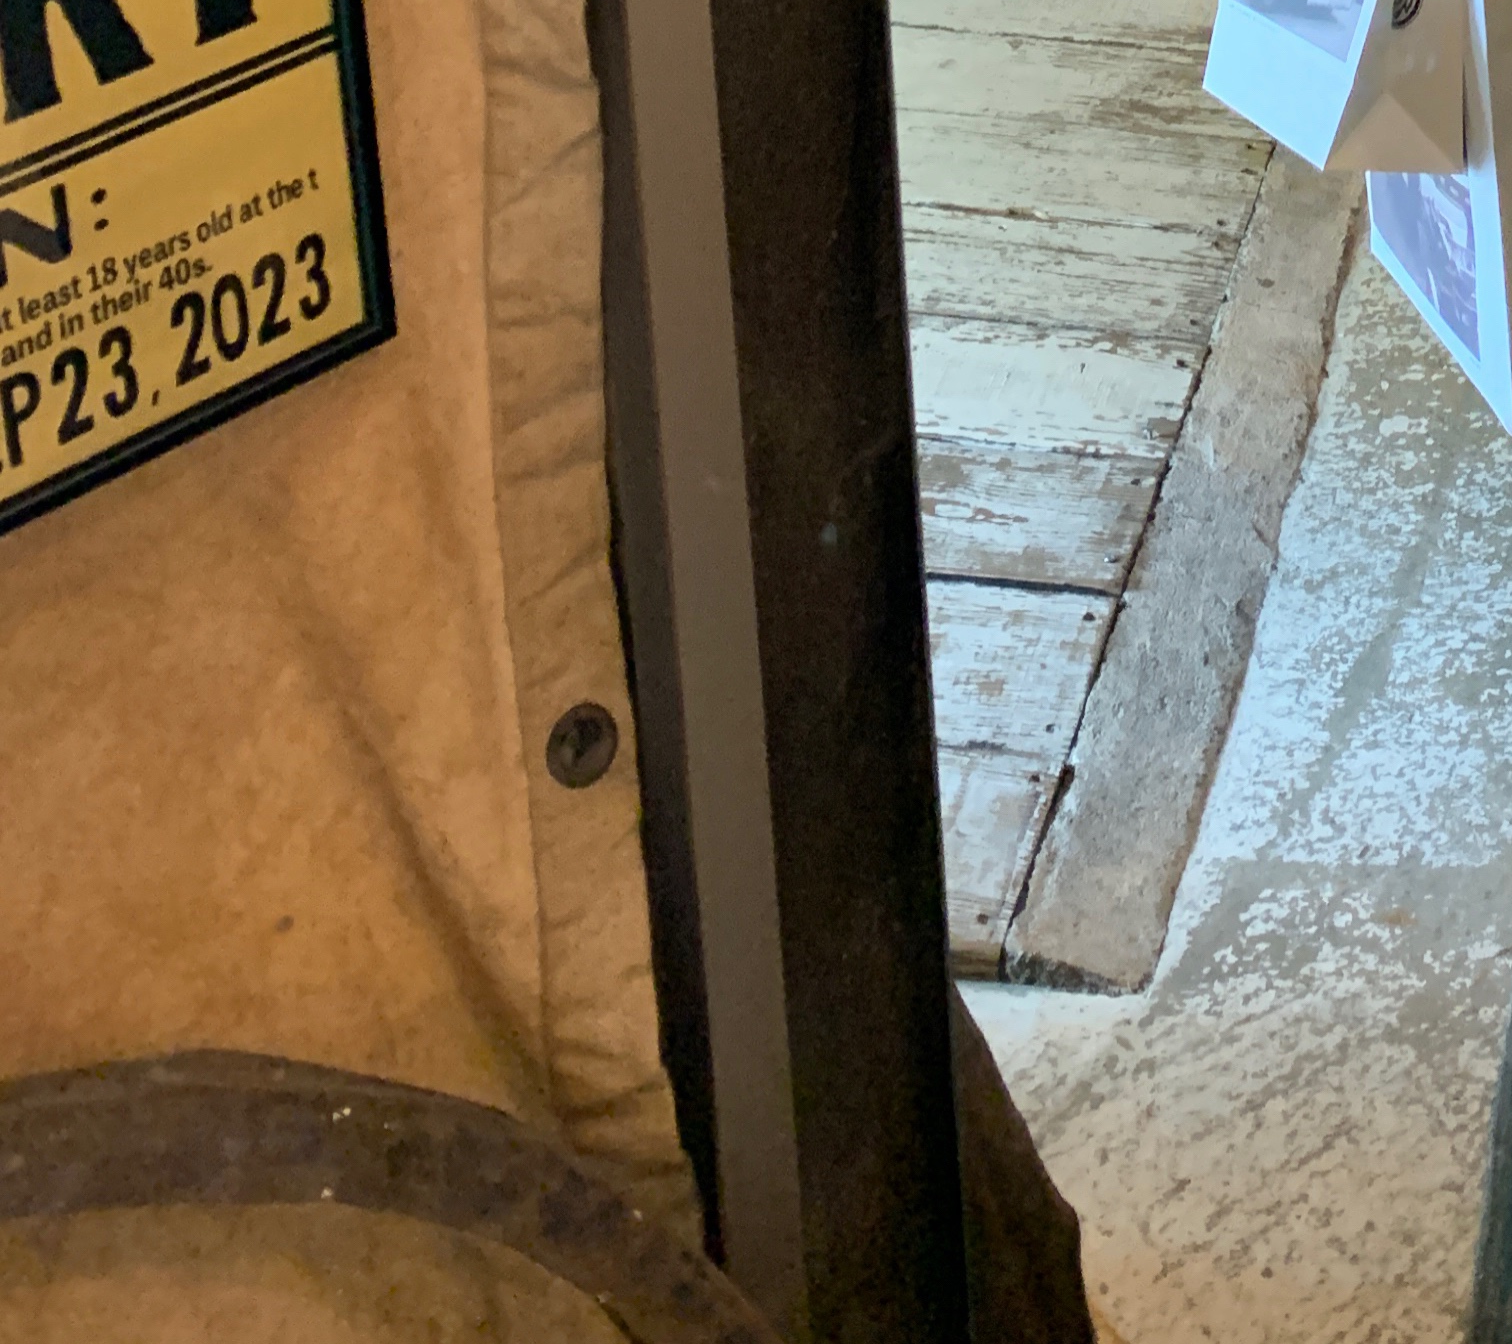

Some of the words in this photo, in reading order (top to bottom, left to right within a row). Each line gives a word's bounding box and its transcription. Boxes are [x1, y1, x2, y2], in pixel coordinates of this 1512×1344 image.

[1, 327, 53, 368] and
[59, 311, 84, 340] in
[91, 277, 153, 326] their
[17, 275, 82, 324] least
[87, 257, 118, 293] 18
[122, 230, 192, 284] years
[196, 204, 234, 243] old
[239, 194, 263, 222] at
[266, 179, 304, 210] the
[308, 168, 319, 191] t
[171, 232, 331, 387] 2023
